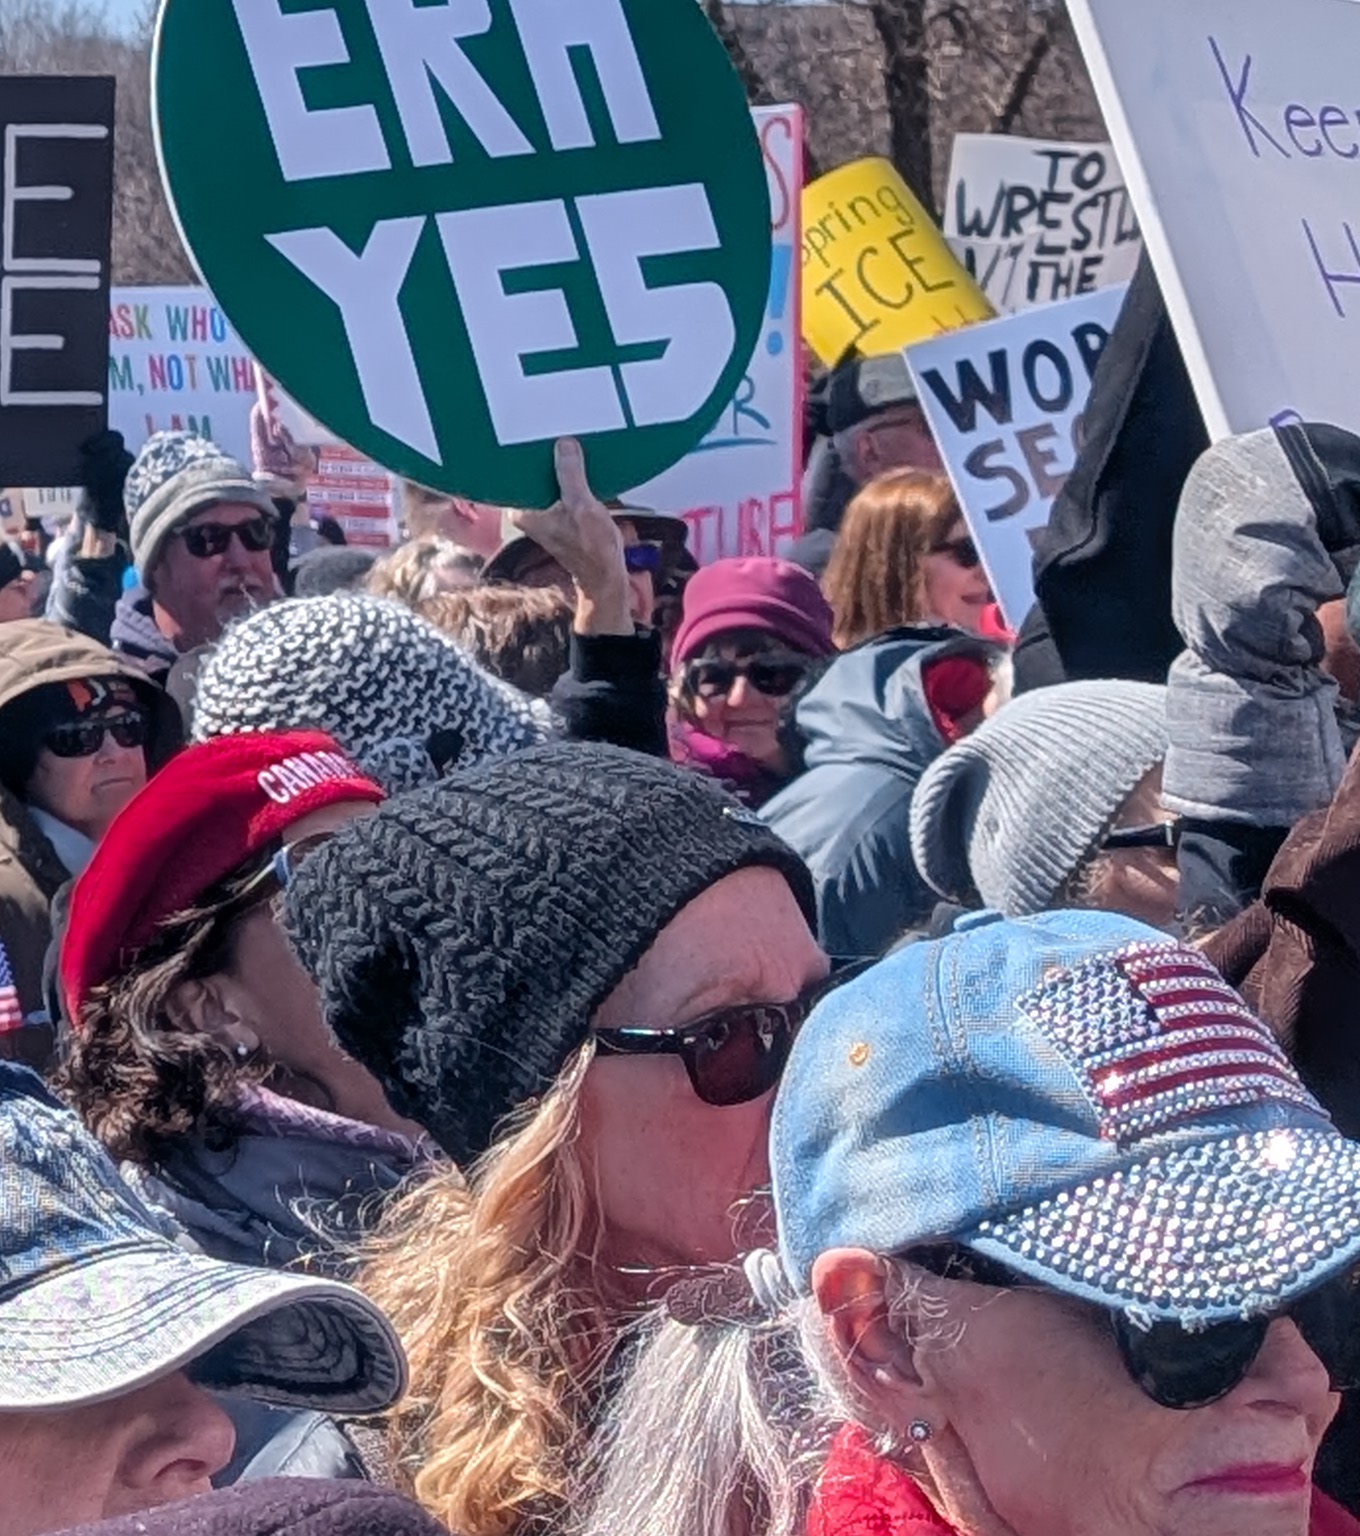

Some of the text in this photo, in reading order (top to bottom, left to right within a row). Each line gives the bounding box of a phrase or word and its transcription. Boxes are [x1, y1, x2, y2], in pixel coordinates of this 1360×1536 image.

[1208, 36, 1360, 159] Kee
[1032, 150, 1107, 192] TO
[166, 304, 226, 343] WHO
[262, 182, 736, 466] YES
[815, 227, 956, 344] ICE
[108, 353, 144, 395] M,
[148, 353, 199, 392] NOT
